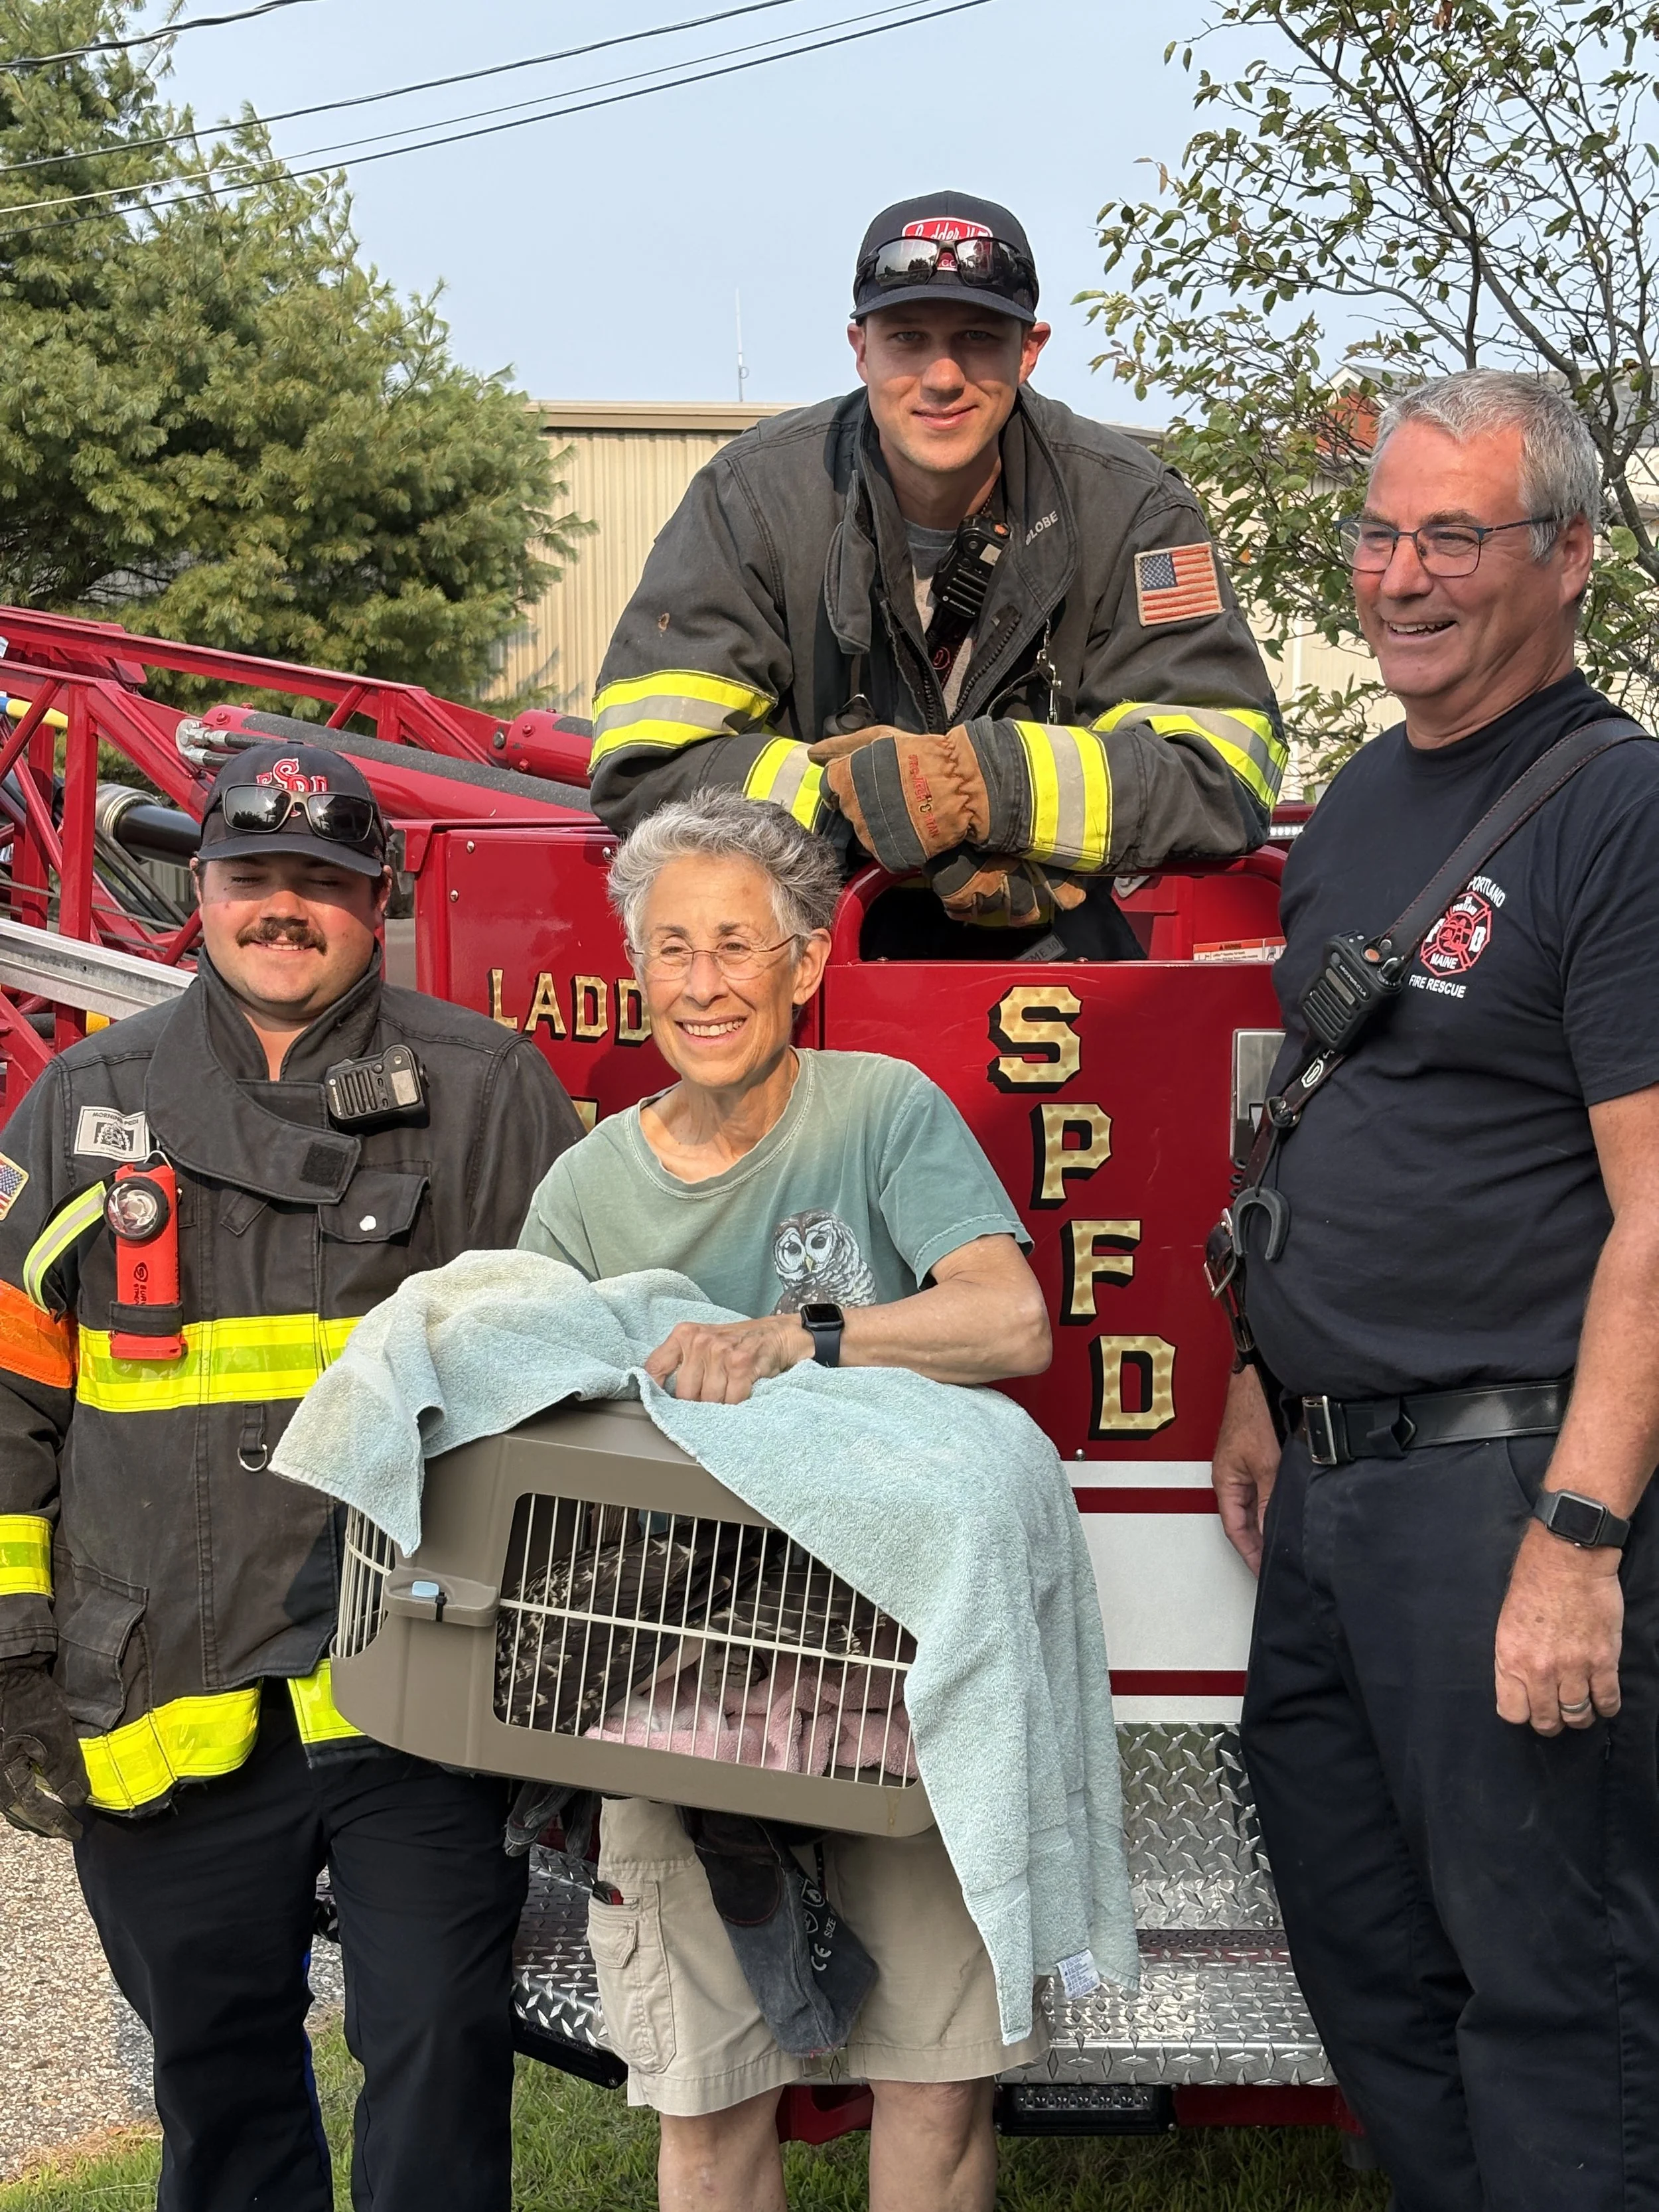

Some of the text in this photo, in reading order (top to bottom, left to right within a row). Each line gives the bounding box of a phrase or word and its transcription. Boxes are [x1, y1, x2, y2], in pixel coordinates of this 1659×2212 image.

[1467, 875, 1506, 909] PORTLAND
[1429, 953, 1459, 970] MAINE
[1408, 974, 1467, 999] FIRE RESCUE
[824, 1917, 837, 1939] SIZE
[811, 1943, 832, 1972] CE
